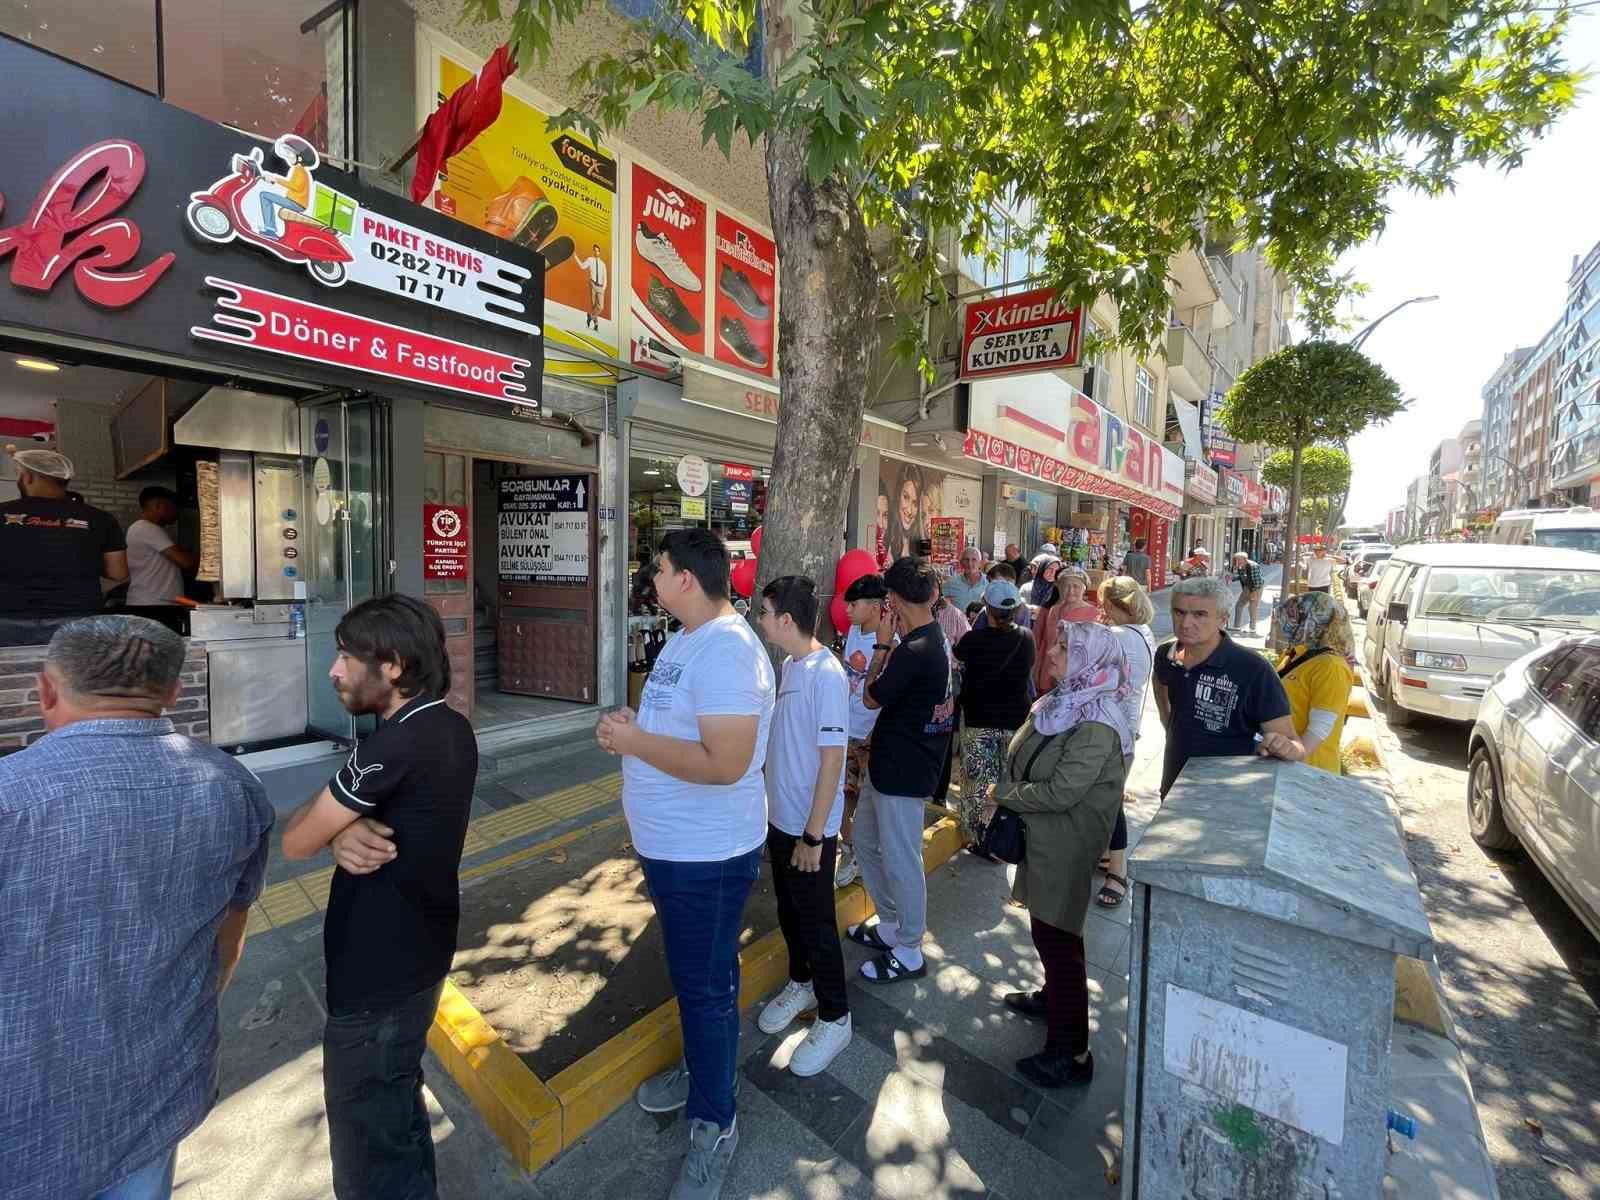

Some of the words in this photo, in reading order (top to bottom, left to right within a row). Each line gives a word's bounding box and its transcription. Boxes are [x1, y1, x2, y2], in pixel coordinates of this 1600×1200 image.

[561, 138, 601, 175] forex
[541, 175, 579, 198] ayaklar
[643, 195, 692, 230] JUMP
[363, 217, 421, 251] PAKET
[424, 239, 482, 273] SERVİS
[371, 241, 430, 275] 0282
[436, 263, 466, 287] 717
[396, 275, 418, 294] 17
[423, 284, 444, 301] 17
[271, 311, 360, 352] Döner
[370, 337, 388, 360] &
[397, 343, 494, 384] Fastfood
[984, 328, 1053, 350] SERVET
[971, 342, 1062, 368] KUNDURA
[501, 479, 570, 492] SORGUNLAR
[500, 513, 551, 525] AVUKAT
[500, 527, 528, 540] BÜLENT
[500, 545, 551, 558] AVUKAT
